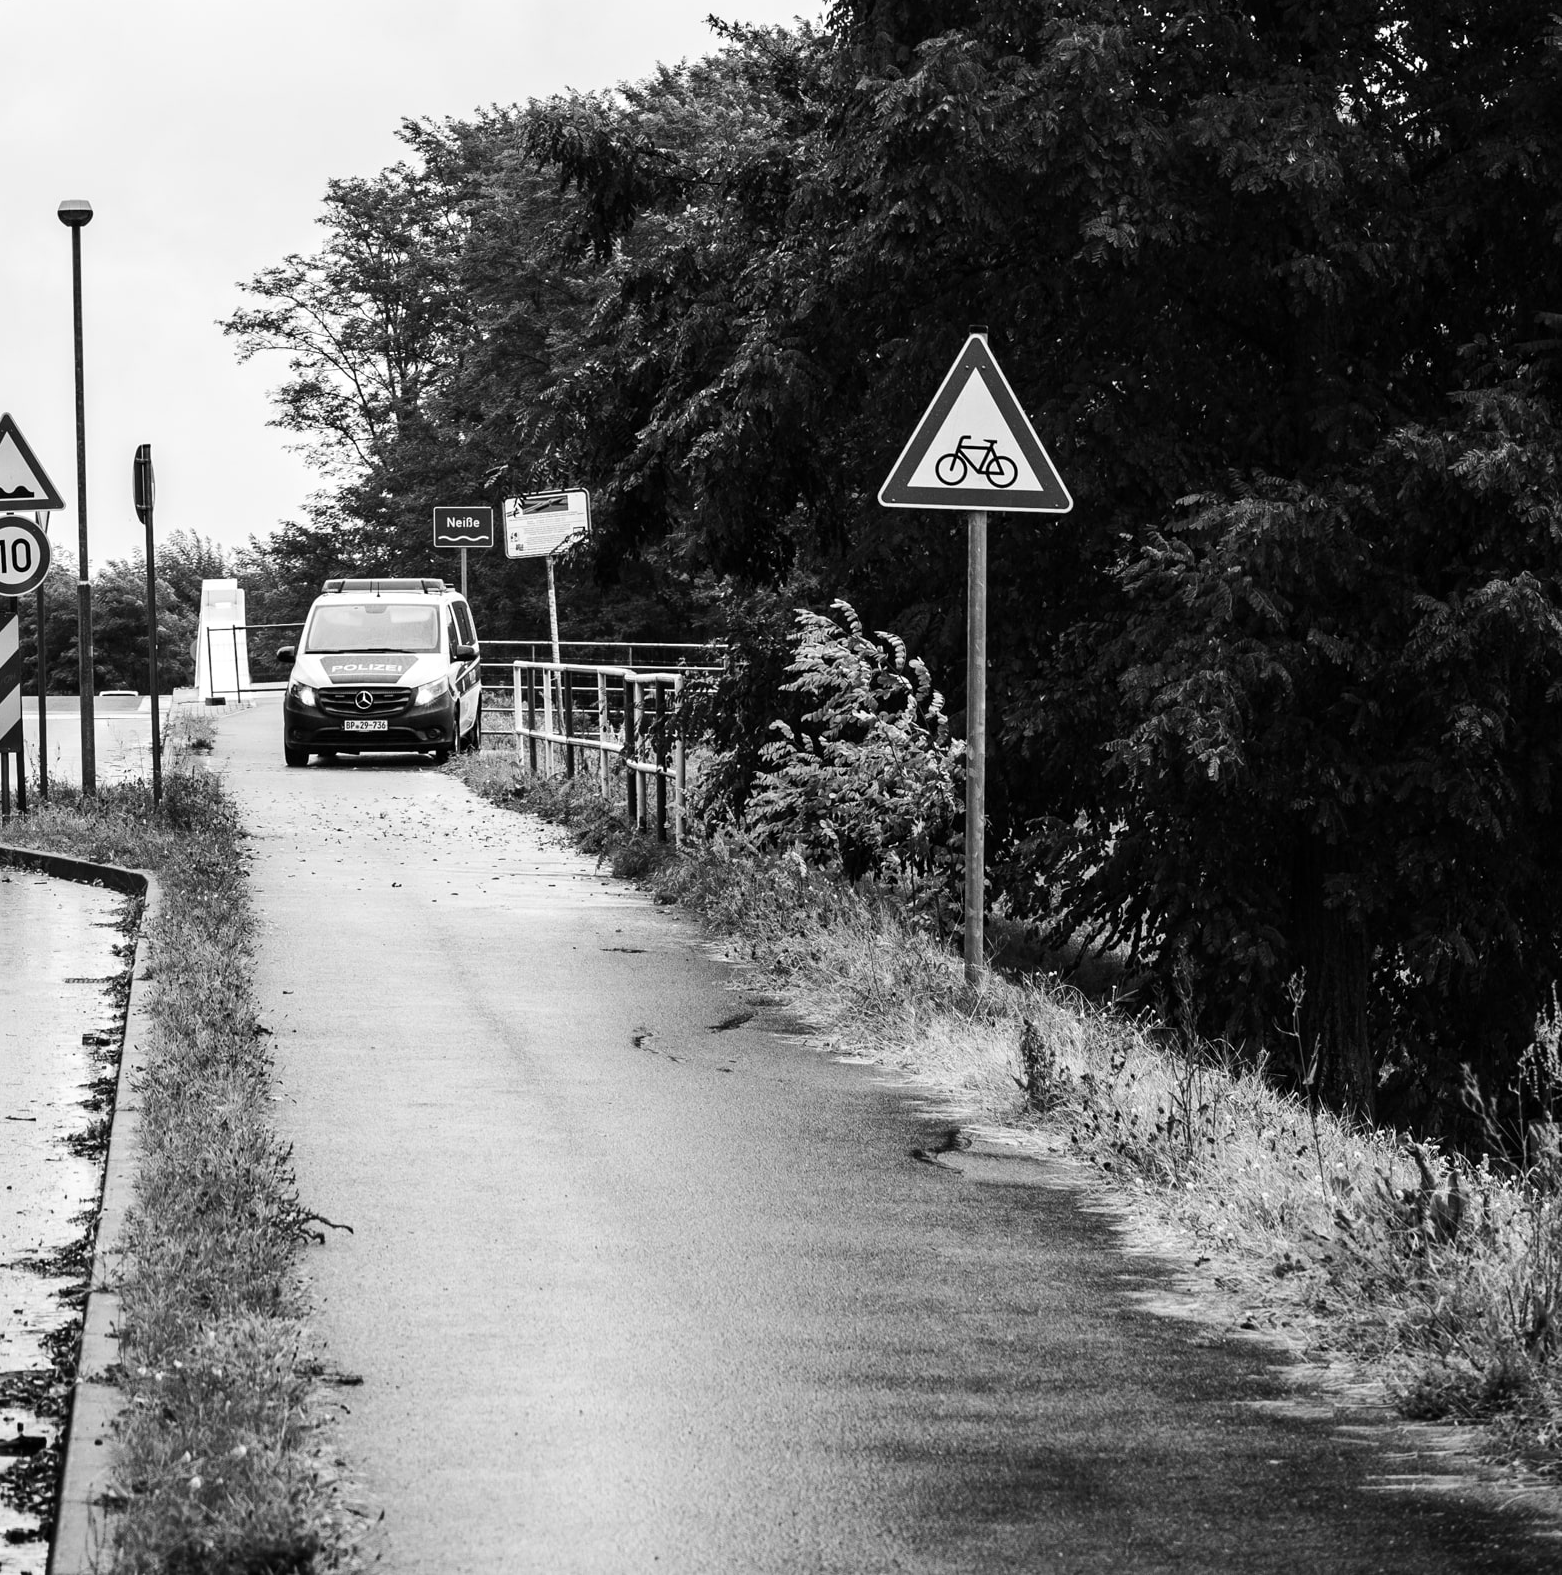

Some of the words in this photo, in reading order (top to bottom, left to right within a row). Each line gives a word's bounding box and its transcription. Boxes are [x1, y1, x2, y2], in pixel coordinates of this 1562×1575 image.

[446, 516, 480, 528] Neiße
[331, 664, 402, 673] POLIZEI
[346, 721, 356, 730] BP
[360, 721, 386, 730] 29-736
